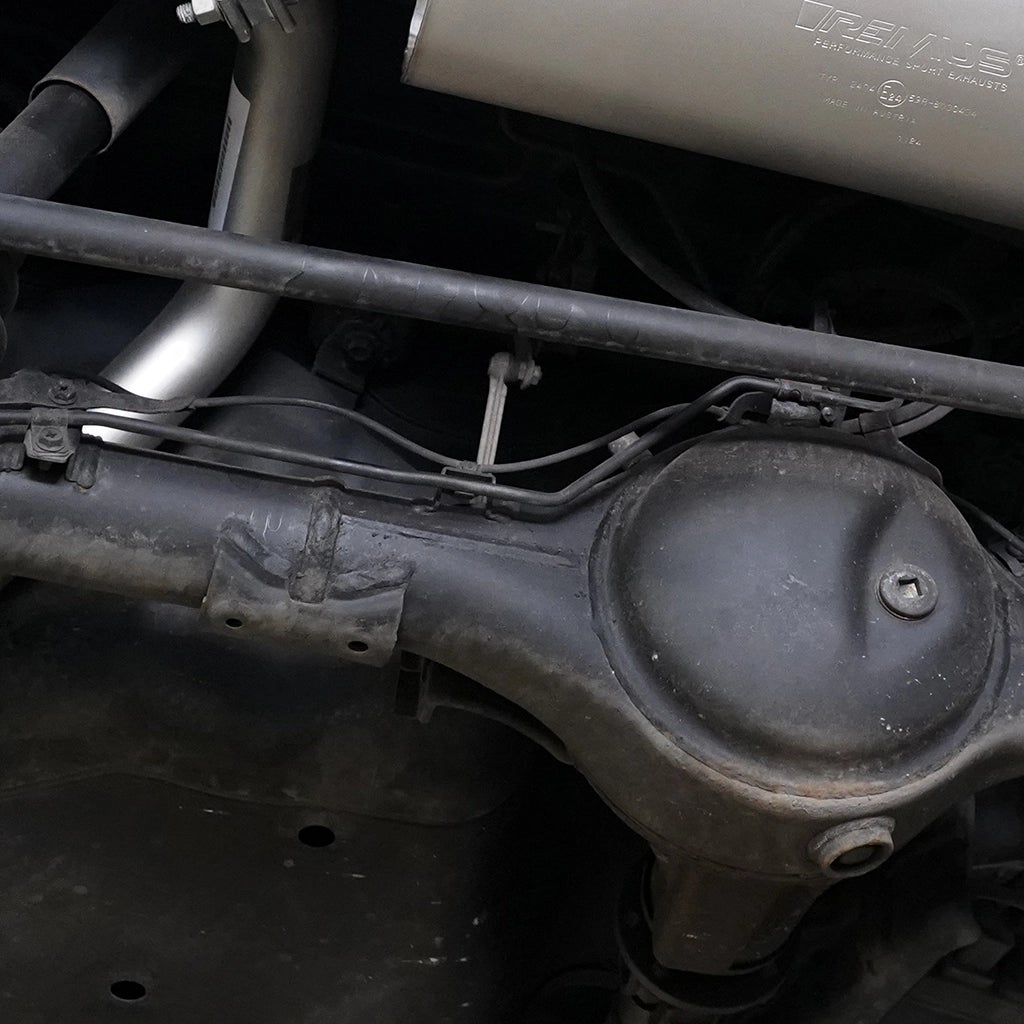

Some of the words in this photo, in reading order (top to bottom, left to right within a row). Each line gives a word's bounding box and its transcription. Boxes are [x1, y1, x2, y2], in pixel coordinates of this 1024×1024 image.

[812, 37, 900, 67] PERFORMANCE
[905, 62, 944, 78] SPORT
[948, 72, 1009, 93] EXHAUSTS
[824, 96, 849, 109] MADE
